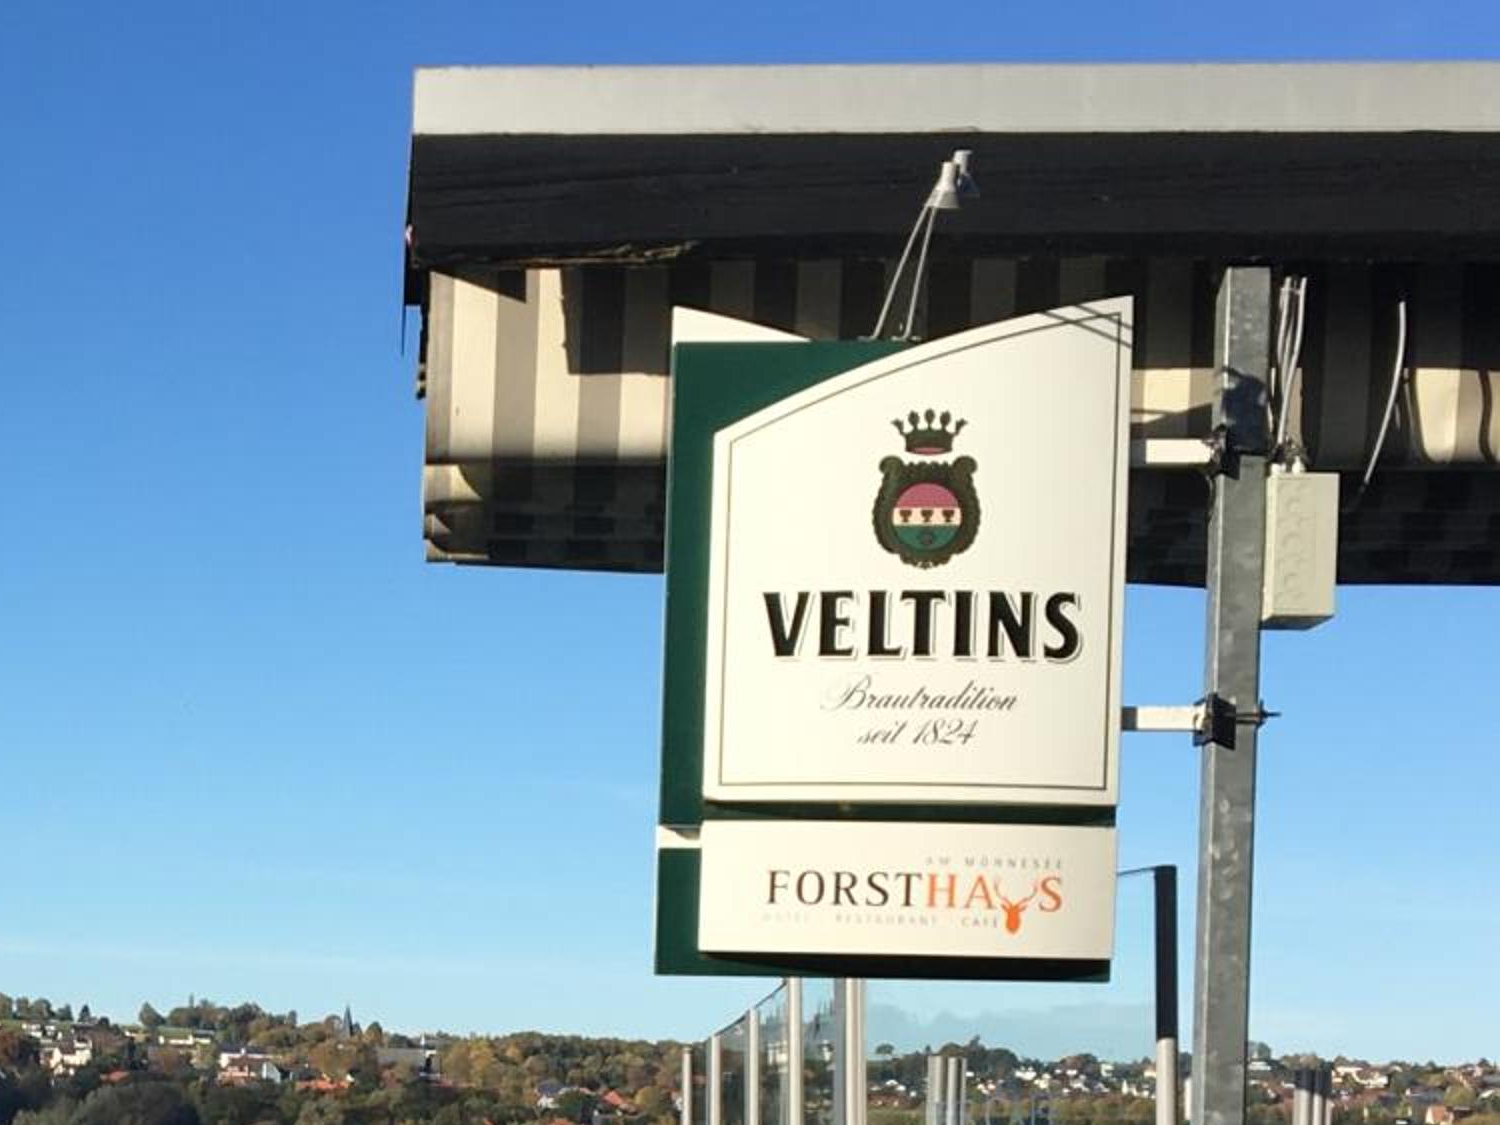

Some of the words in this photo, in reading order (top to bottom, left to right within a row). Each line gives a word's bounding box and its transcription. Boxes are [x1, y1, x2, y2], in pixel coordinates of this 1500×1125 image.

[762, 590, 1084, 663] VELTINS
[820, 674, 1018, 711] Brautradition
[856, 720, 908, 745] seit
[912, 718, 979, 745] 1824
